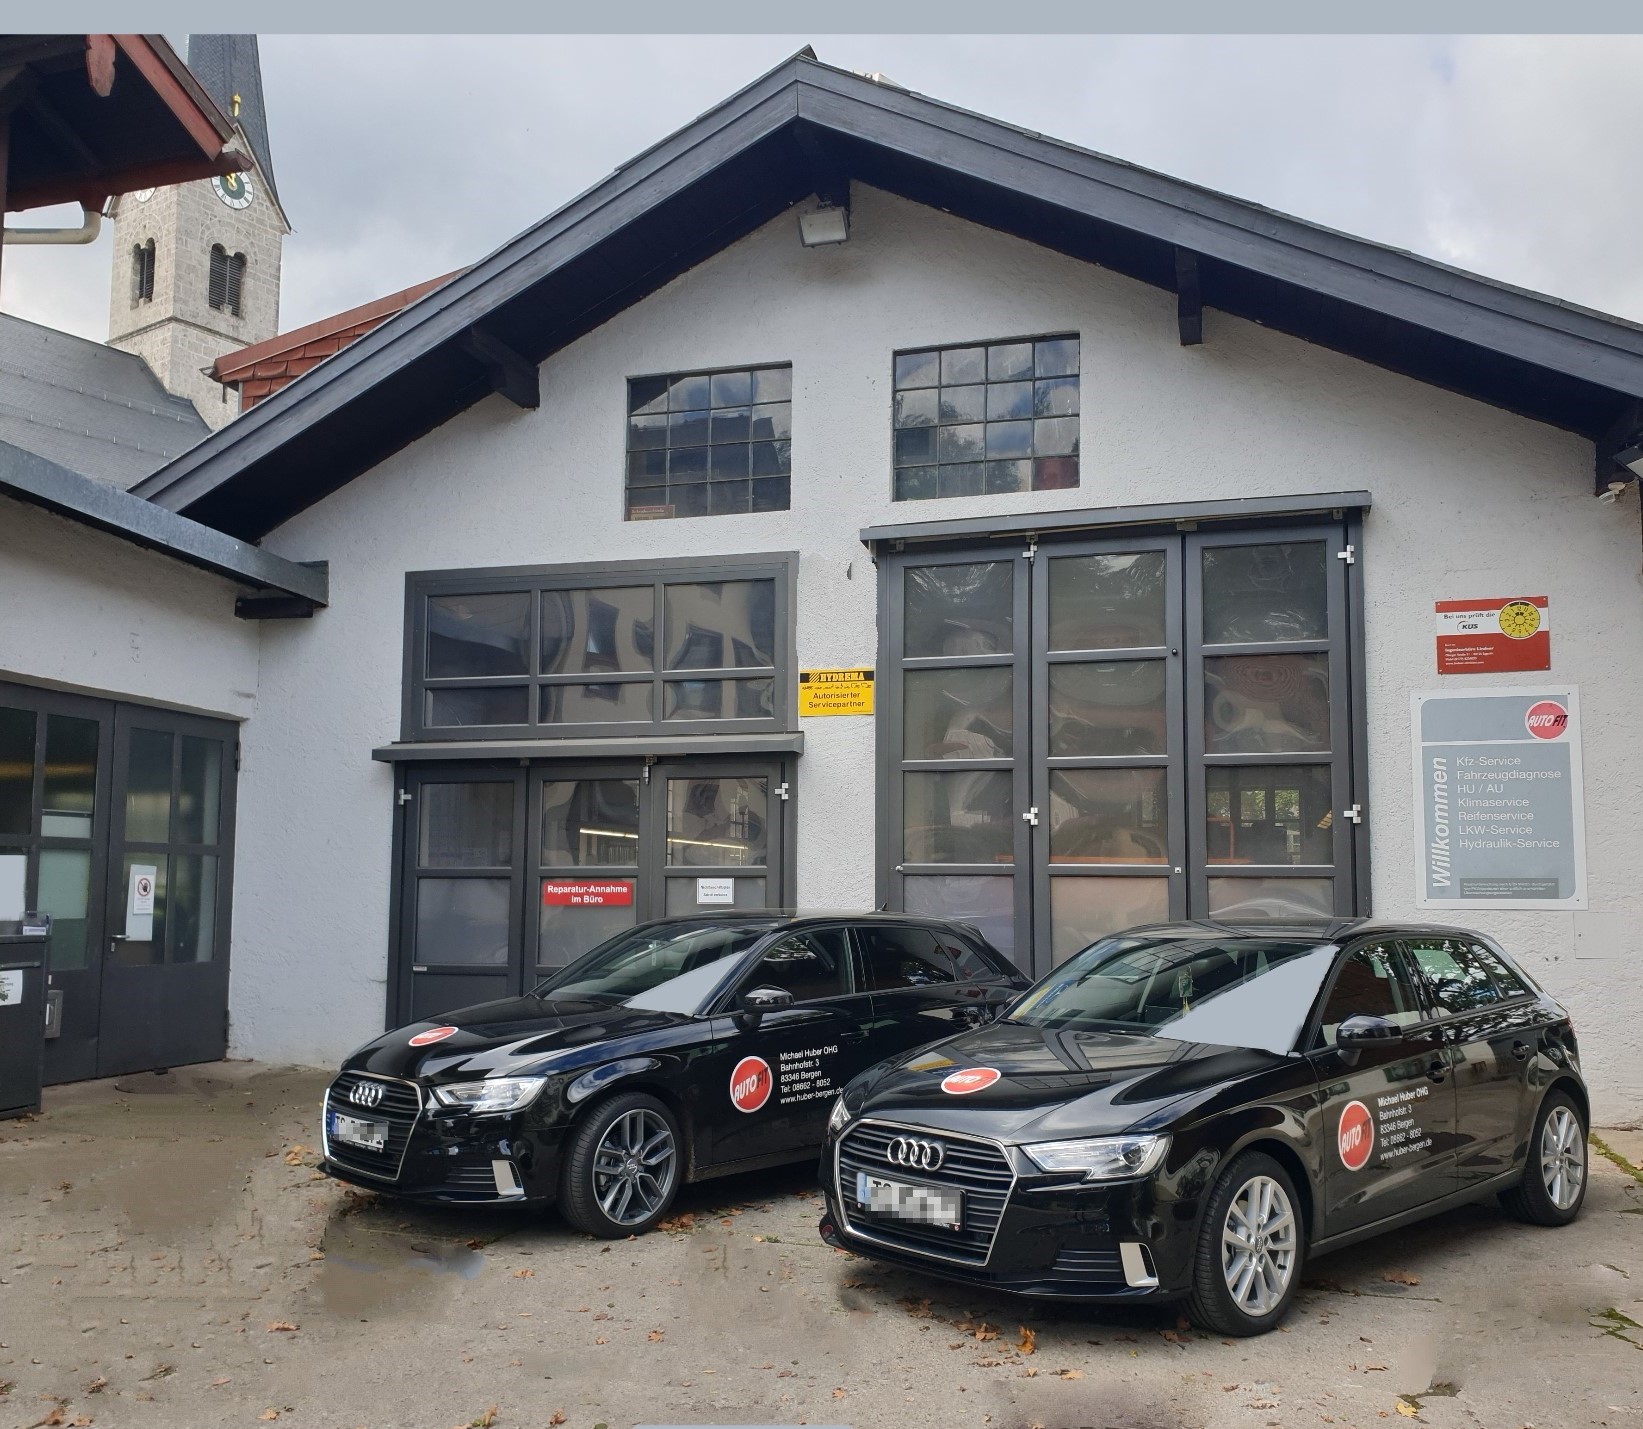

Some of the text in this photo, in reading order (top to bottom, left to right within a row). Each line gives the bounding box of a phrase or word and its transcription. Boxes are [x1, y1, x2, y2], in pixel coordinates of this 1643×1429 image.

[820, 672, 865, 682] HYDREMA
[1457, 756, 1521, 767] Kfz-Service
[1457, 770, 1561, 782] Fahrzeugdiagnose
[1458, 784, 1475, 793] HU
[1486, 784, 1503, 793] AU
[1458, 798, 1530, 807] Klimaservice
[1459, 811, 1534, 821] Reifenservice
[1432, 757, 1451, 887] Willkommen
[1459, 825, 1533, 835] LKW-Service
[1459, 838, 1560, 850] Hydraulik-Service
[548, 885, 628, 895] Reparatur-Annahme
[584, 895, 603, 903] Büro
[780, 1045, 838, 1061] Michael Huber OHG
[801, 1070, 821, 1080] Bergen
[1378, 1086, 1428, 1107] Michael Huber OHG
[1397, 1118, 1414, 1130] Bergen
